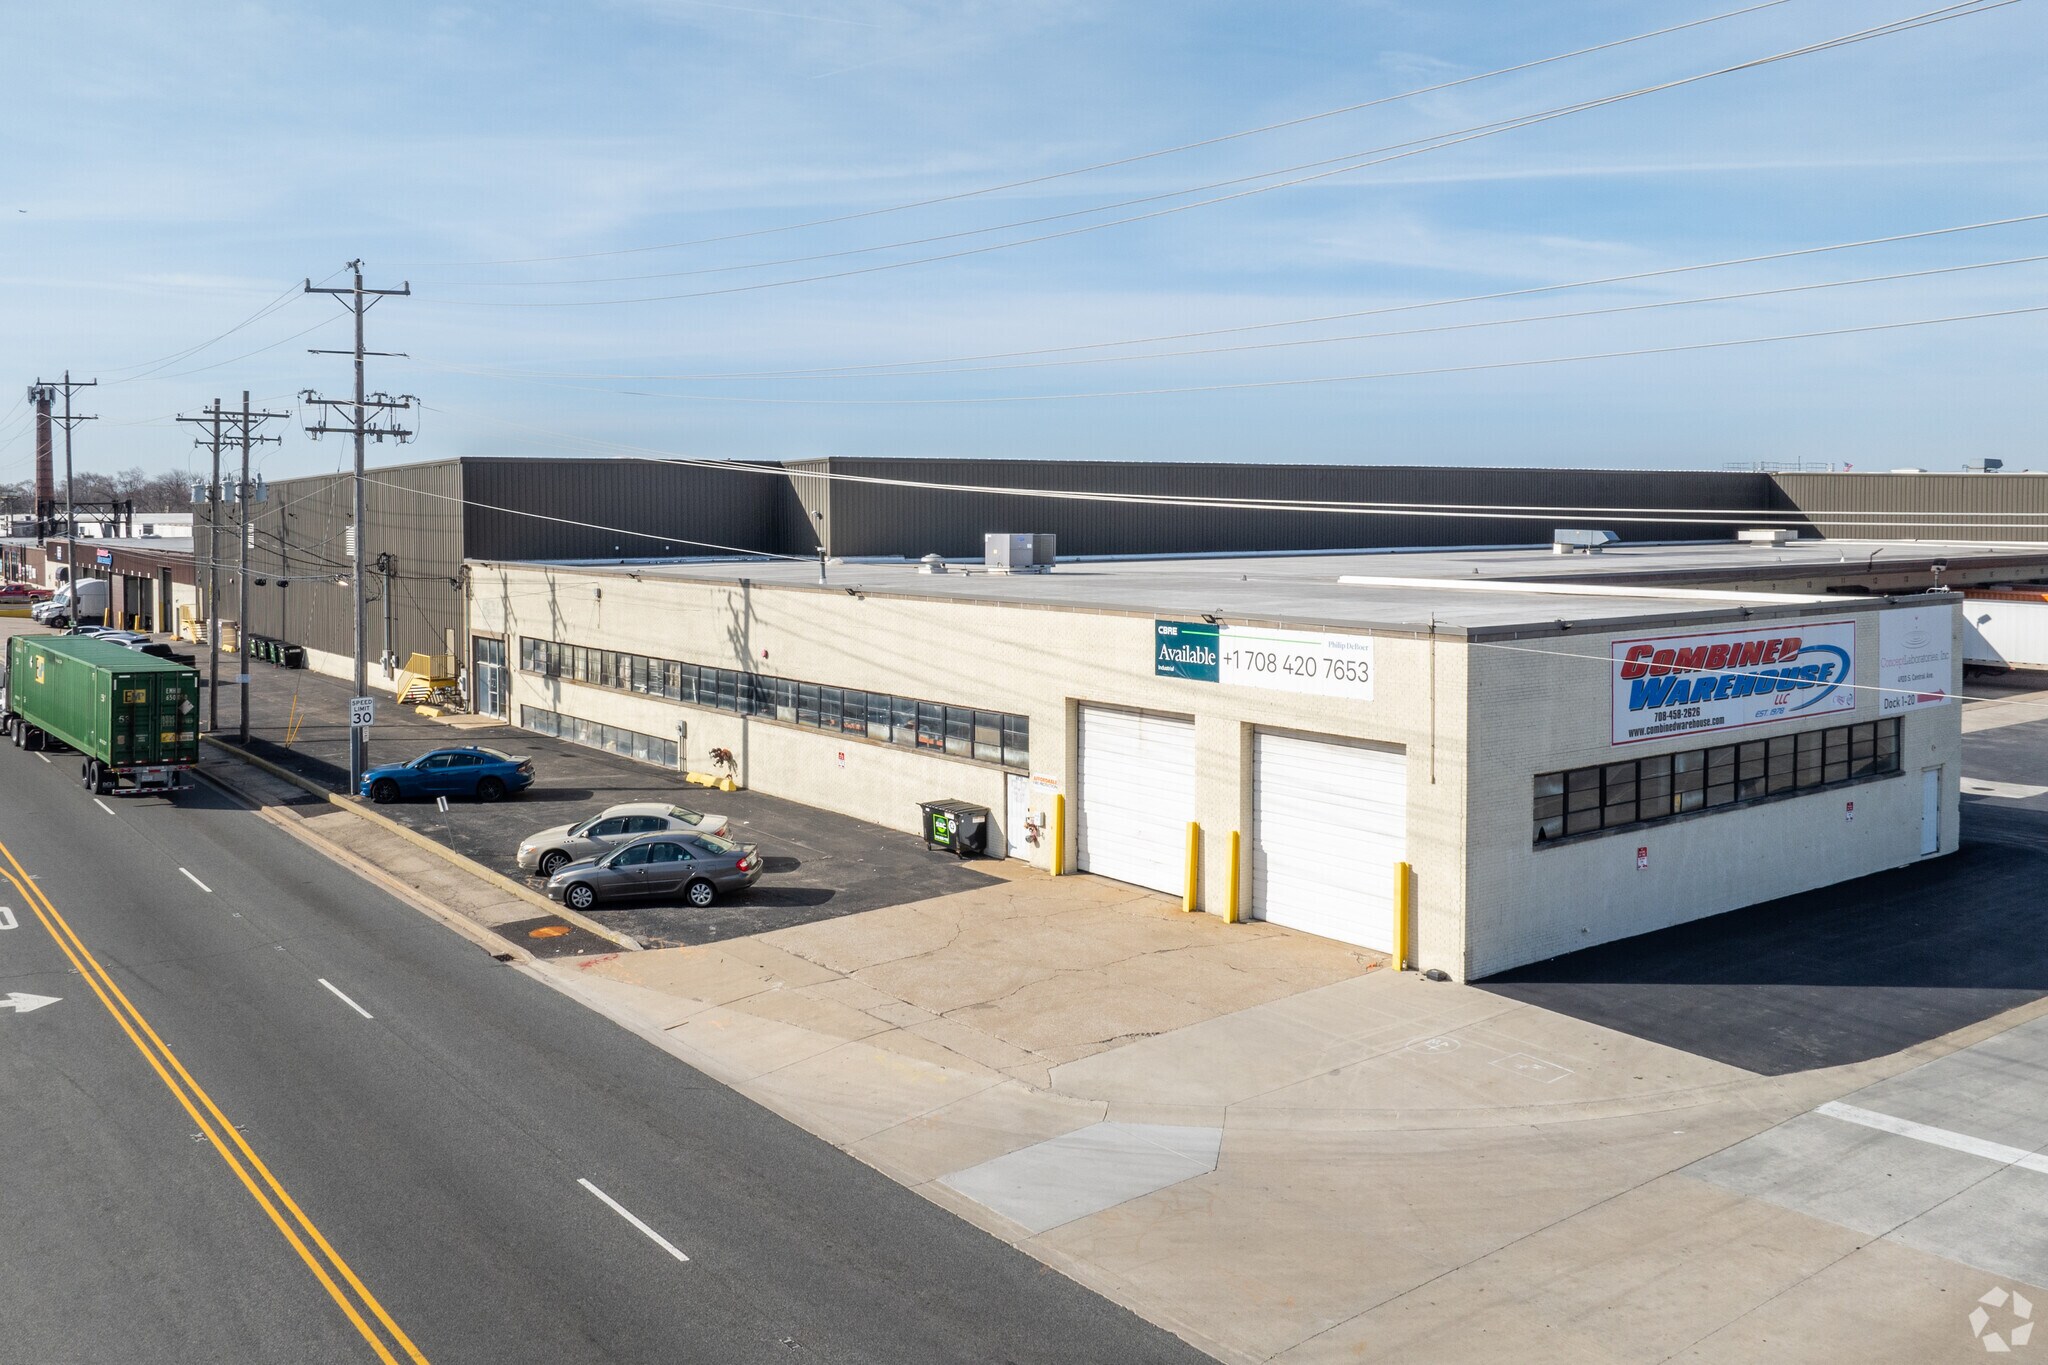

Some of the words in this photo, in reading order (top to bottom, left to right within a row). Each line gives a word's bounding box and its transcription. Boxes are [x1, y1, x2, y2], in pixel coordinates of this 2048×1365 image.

[1158, 625, 1178, 636] CBRE
[1158, 643, 1217, 666] Available
[1620, 637, 1803, 680] COMBINED
[1223, 650, 1239, 670] +1
[1244, 650, 1277, 673] 708
[1283, 655, 1317, 677] 420
[1323, 658, 1369, 683] 7653
[1629, 662, 1835, 712] WAREHOUSE
[1774, 693, 1791, 705] LLC
[1884, 697, 1900, 709] Dock
[1901, 694, 1916, 706] 1-20
[353, 712, 372, 724] 30
[1654, 706, 1701, 723] 708-458-2626
[1628, 716, 1725, 738] www.combinedwarehouse.com
